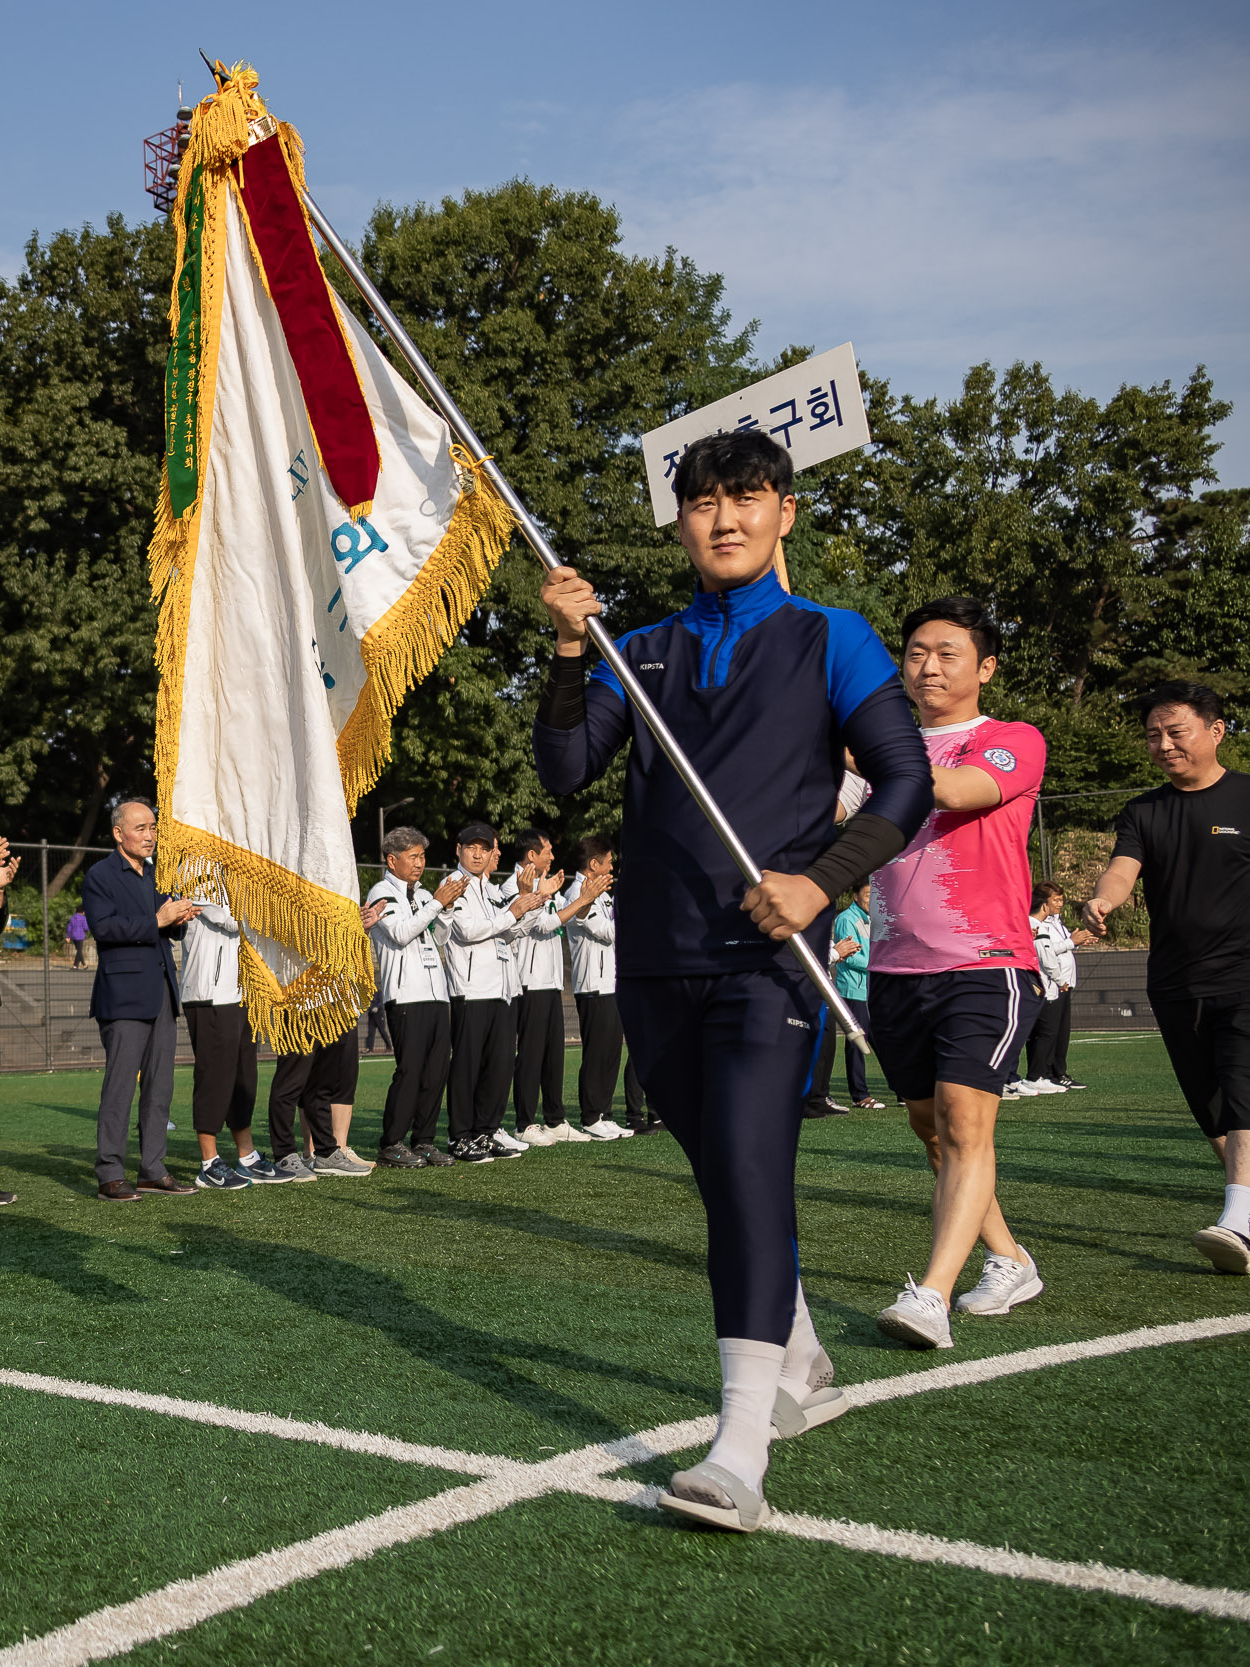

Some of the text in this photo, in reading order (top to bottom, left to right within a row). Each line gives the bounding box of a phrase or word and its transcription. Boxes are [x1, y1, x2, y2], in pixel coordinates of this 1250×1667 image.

[184, 367, 197, 406] 광진구
[183, 413, 194, 472] 축구대회
[787, 1017, 810, 1029] KIPSTA
